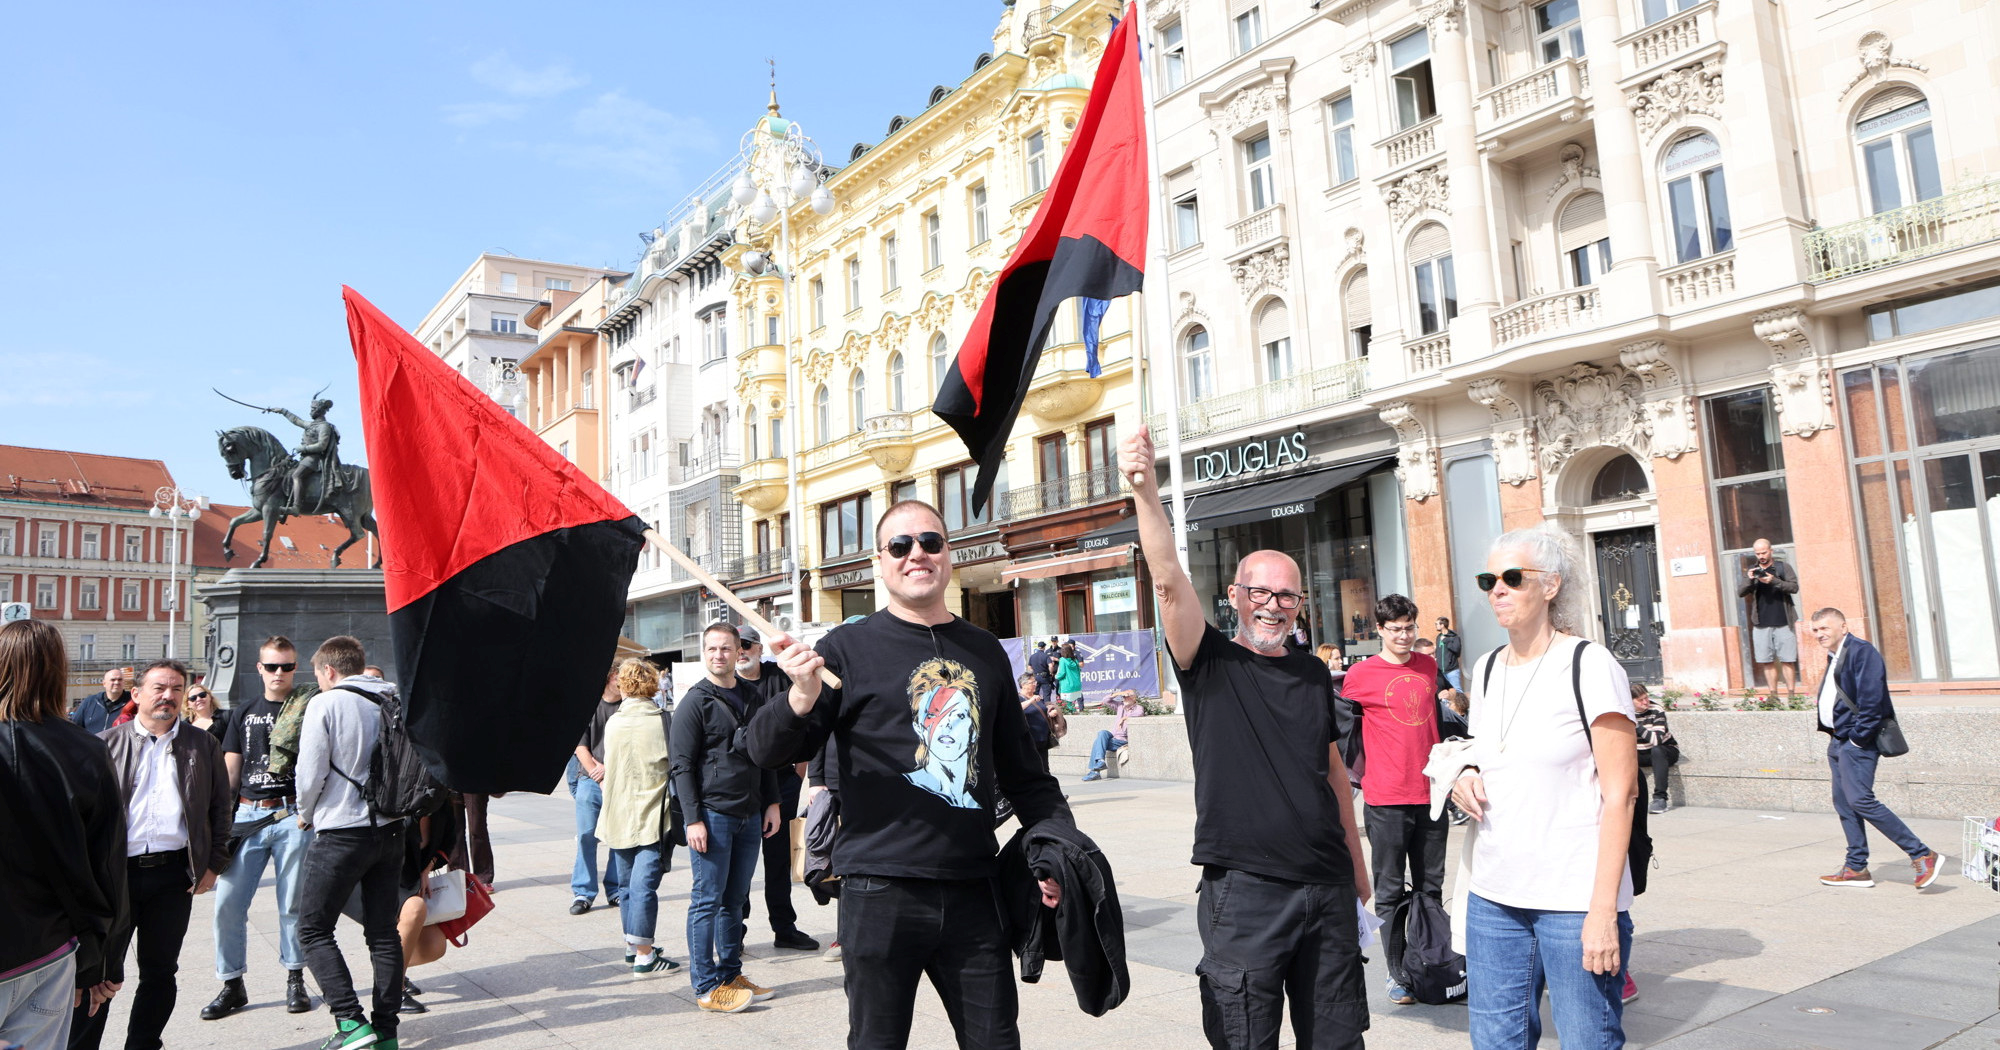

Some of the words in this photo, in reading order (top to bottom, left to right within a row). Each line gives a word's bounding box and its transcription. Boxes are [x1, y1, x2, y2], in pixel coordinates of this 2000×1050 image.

[1860, 122, 1879, 132] KLUB
[1194, 431, 1307, 483] DOUGLAS
[1271, 503, 1304, 518] DOUGLAS
[1084, 537, 1109, 549] DOUGLAS
[956, 545, 997, 562] HARMICA
[1080, 669, 1116, 683] PROJEKT
[1118, 669, 1141, 680] d.o.o.
[244, 712, 274, 726] Fuck
